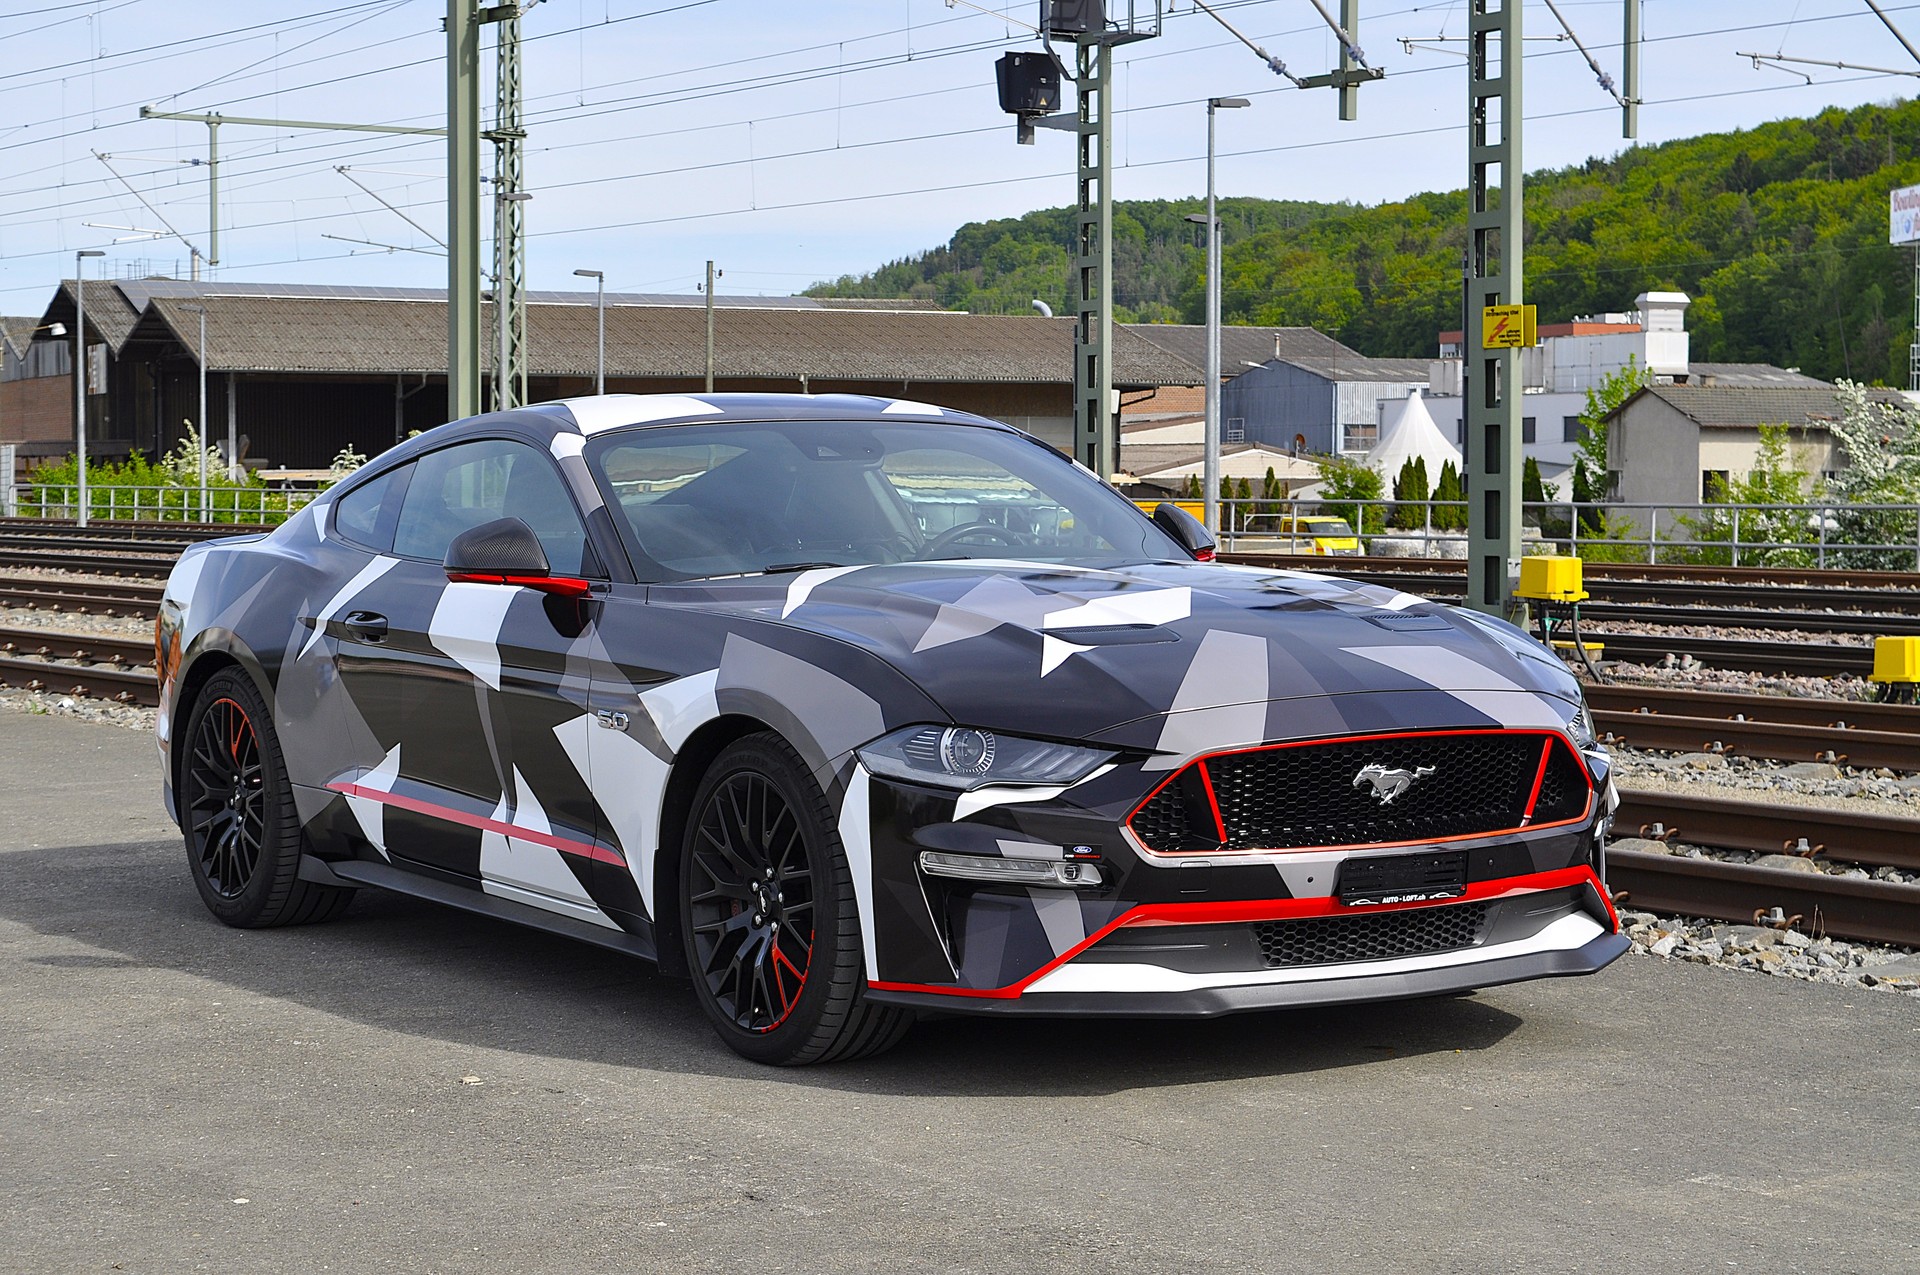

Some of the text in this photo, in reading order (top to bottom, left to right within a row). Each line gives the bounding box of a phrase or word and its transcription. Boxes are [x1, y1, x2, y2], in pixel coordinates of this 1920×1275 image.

[597, 709, 630, 731] 5.0
[1382, 896, 1399, 904] AUTO
[1403, 894, 1426, 902] LOFT.ch
